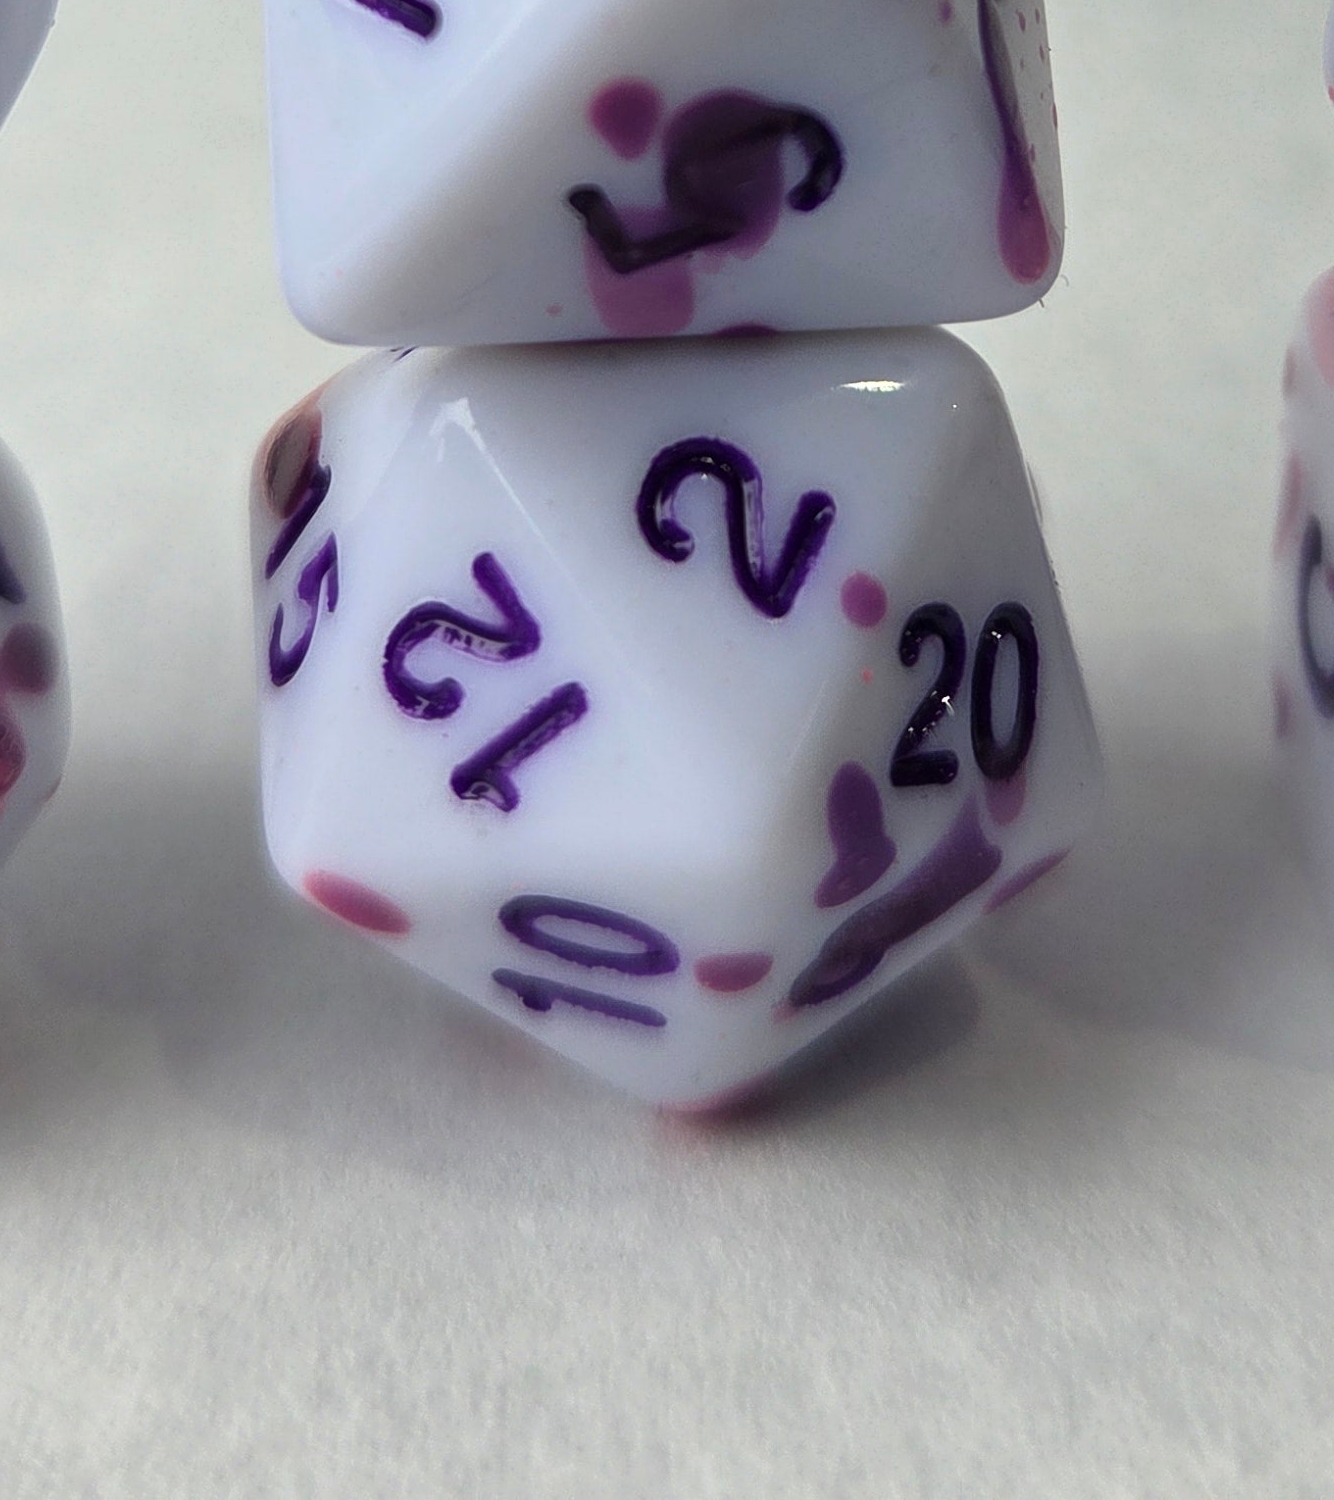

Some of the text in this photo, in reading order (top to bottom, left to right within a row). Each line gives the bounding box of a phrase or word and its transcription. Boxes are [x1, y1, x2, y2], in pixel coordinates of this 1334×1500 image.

[635, 436, 837, 618] 2
[382, 550, 589, 812] 12
[889, 602, 1040, 788] 20
[491, 893, 681, 1027] 10
